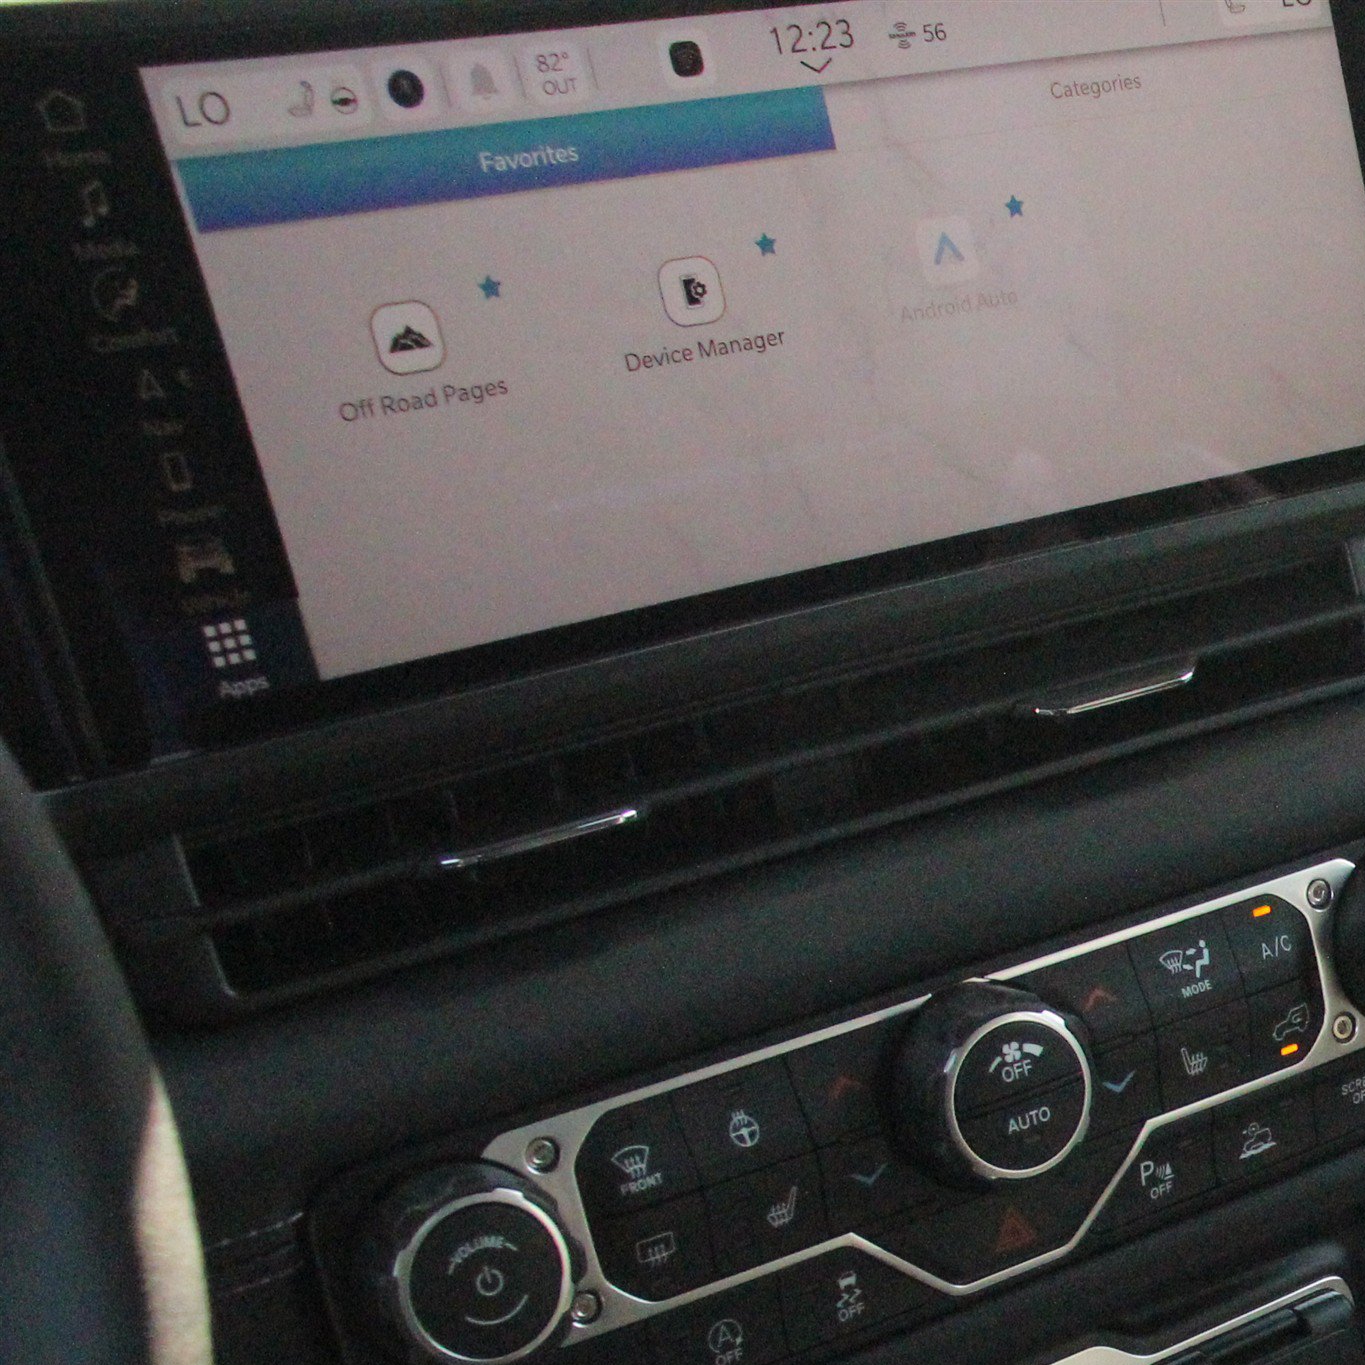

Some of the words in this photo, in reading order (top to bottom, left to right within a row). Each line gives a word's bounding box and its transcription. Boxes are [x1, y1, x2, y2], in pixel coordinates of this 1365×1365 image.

[769, 20, 855, 56] 12:23
[923, 22, 947, 42] 56
[542, 78, 578, 96] OUT
[1050, 74, 1142, 99] Categories
[176, 91, 231, 127] LO
[479, 143, 579, 173] Favorites
[901, 295, 971, 322] Android
[625, 346, 694, 373] Device
[698, 330, 786, 359] Manager
[339, 398, 375, 424] Off
[382, 387, 438, 414] Road
[444, 378, 509, 406] Pages
[220, 677, 270, 698] Apps
[1261, 935, 1292, 960] A/C
[1181, 979, 1213, 999] MODE
[1001, 1059, 1034, 1083] OFF
[1008, 1106, 1051, 1135] AUTO
[620, 1171, 663, 1196] FRONT
[1150, 1182, 1173, 1199] OFF
[451, 1235, 504, 1264] VOLUME
[838, 1302, 865, 1322] OFF
